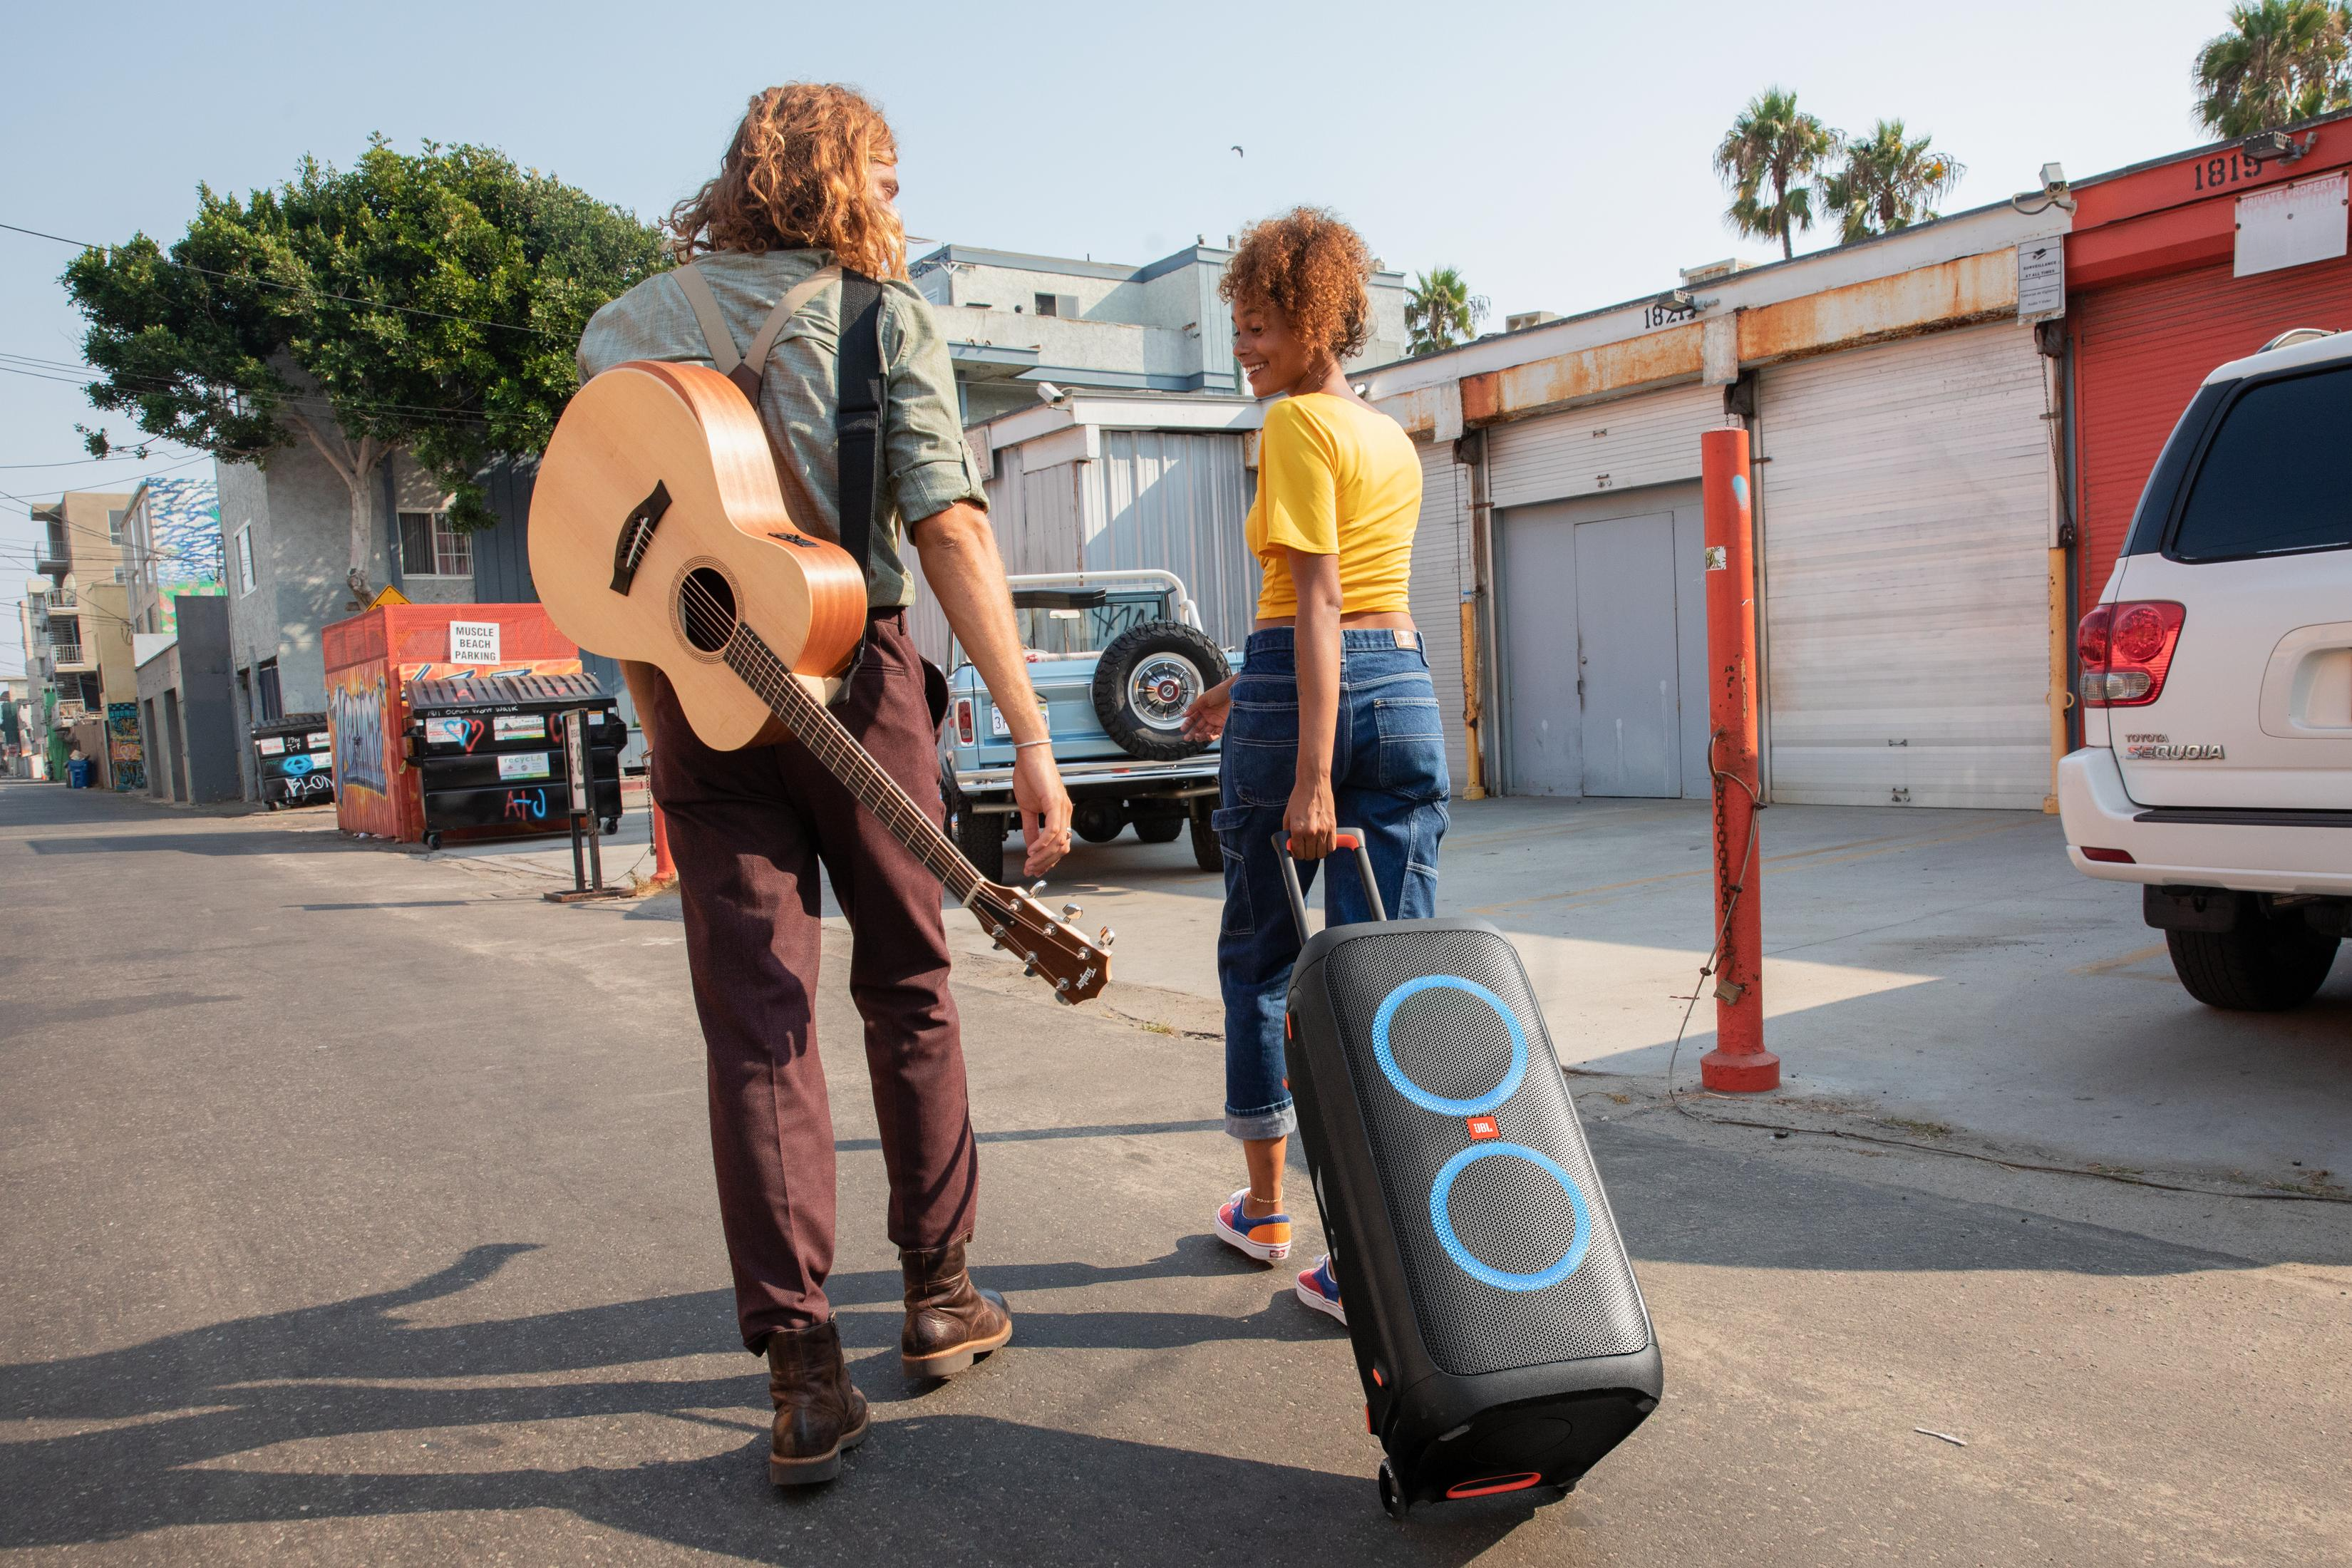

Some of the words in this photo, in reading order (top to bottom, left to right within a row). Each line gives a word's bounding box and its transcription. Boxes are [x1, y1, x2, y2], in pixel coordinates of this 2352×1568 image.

[2242, 190, 2283, 208] PRIVATE
[2286, 175, 2342, 198] PROPERTY
[2023, 261, 2057, 271] SURVEILLANCE
[456, 626, 494, 636] MUSCLE
[460, 639, 490, 649] BEACH
[455, 650, 496, 661] PARKING
[2125, 733, 2169, 743] TOYOTA
[2125, 745, 2225, 760] SEQUOIA
[1076, 966, 1097, 990] Taylor
[1473, 1123, 1493, 1133] JBL
